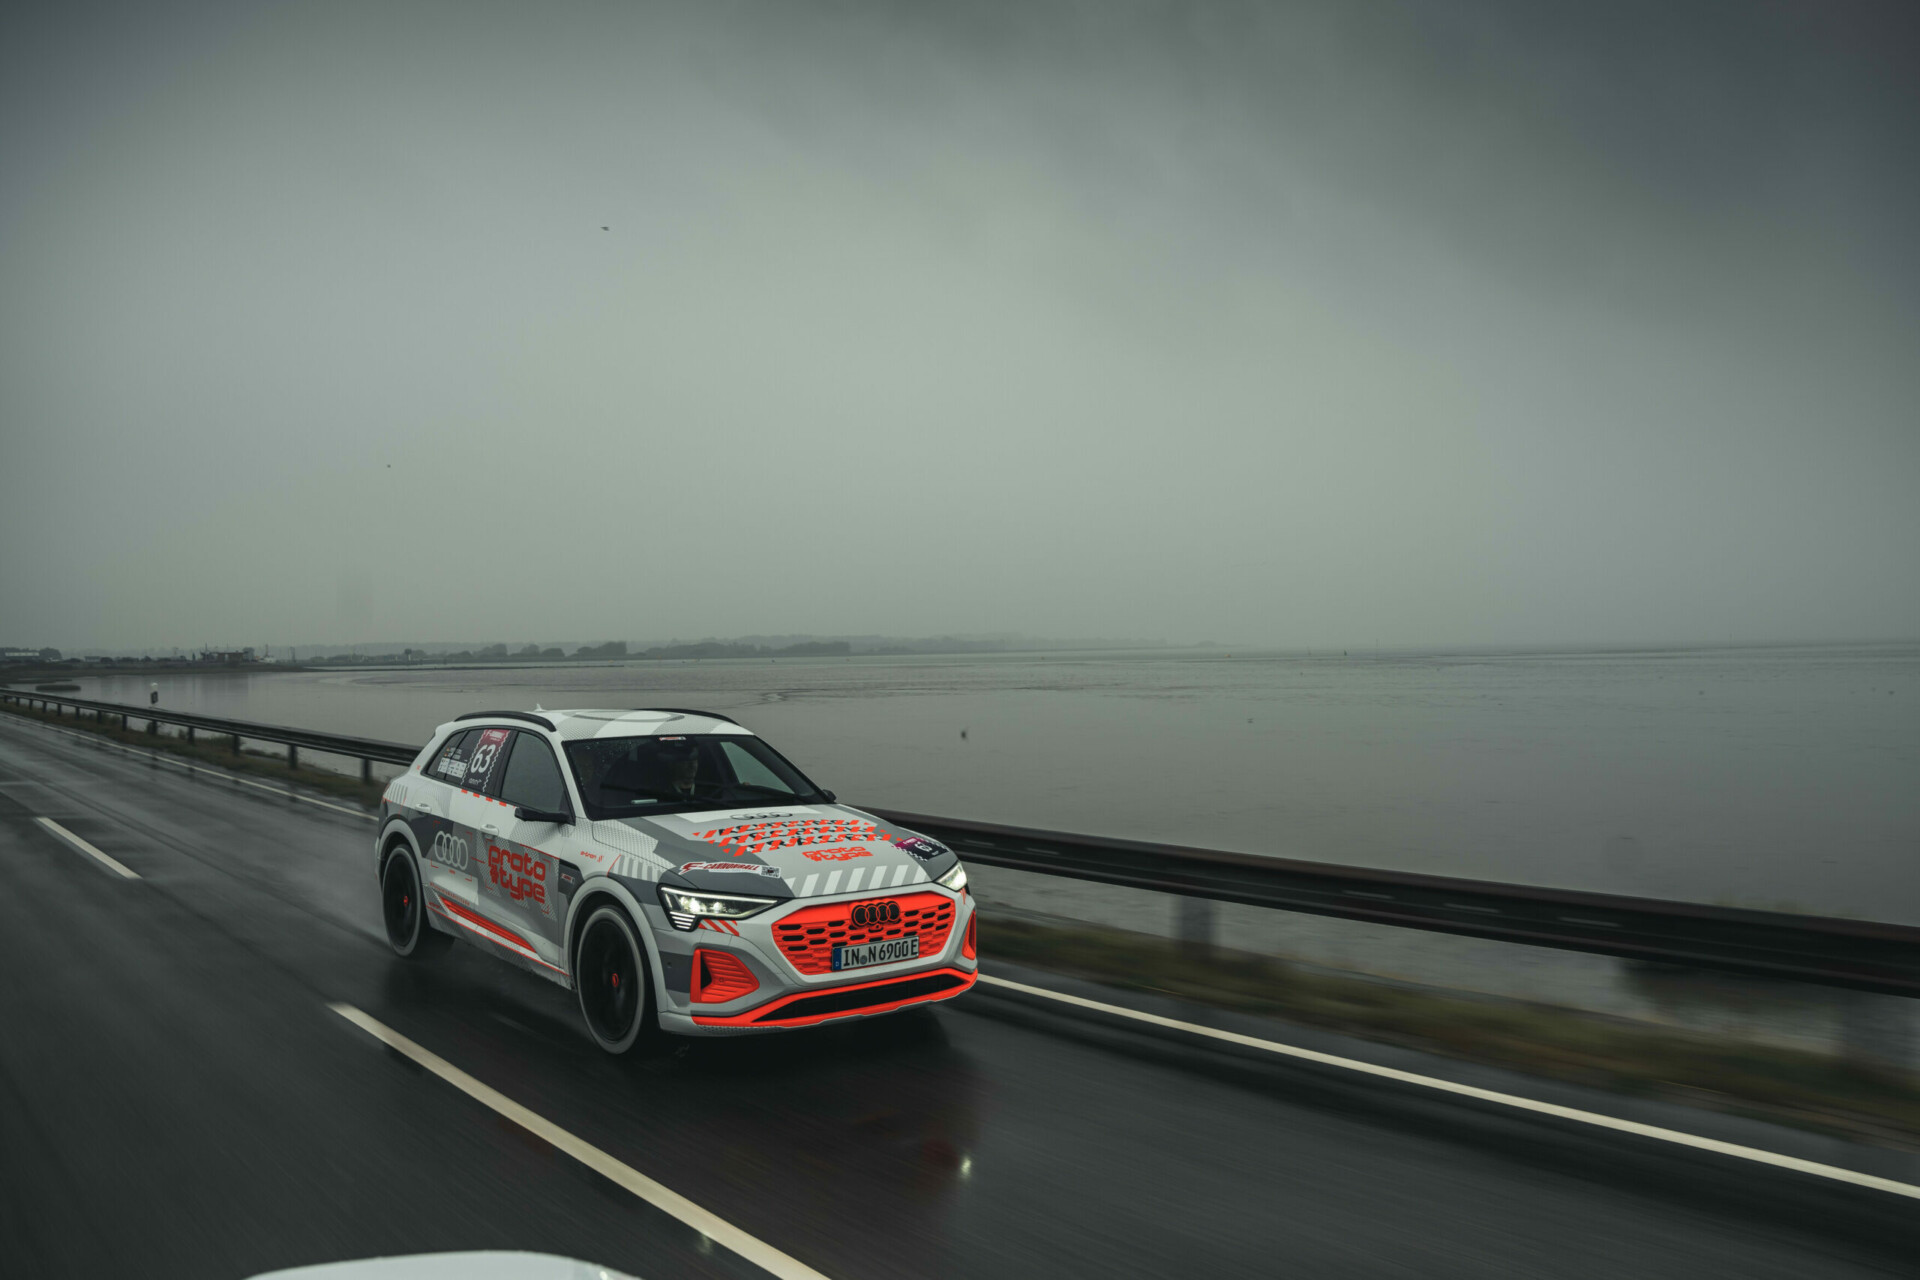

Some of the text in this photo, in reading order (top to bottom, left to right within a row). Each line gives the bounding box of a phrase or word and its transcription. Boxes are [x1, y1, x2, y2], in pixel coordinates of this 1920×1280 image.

[470, 744, 496, 773] 63
[488, 845, 546, 881] proto
[802, 846, 866, 859] proto
[843, 948, 860, 967] IN
